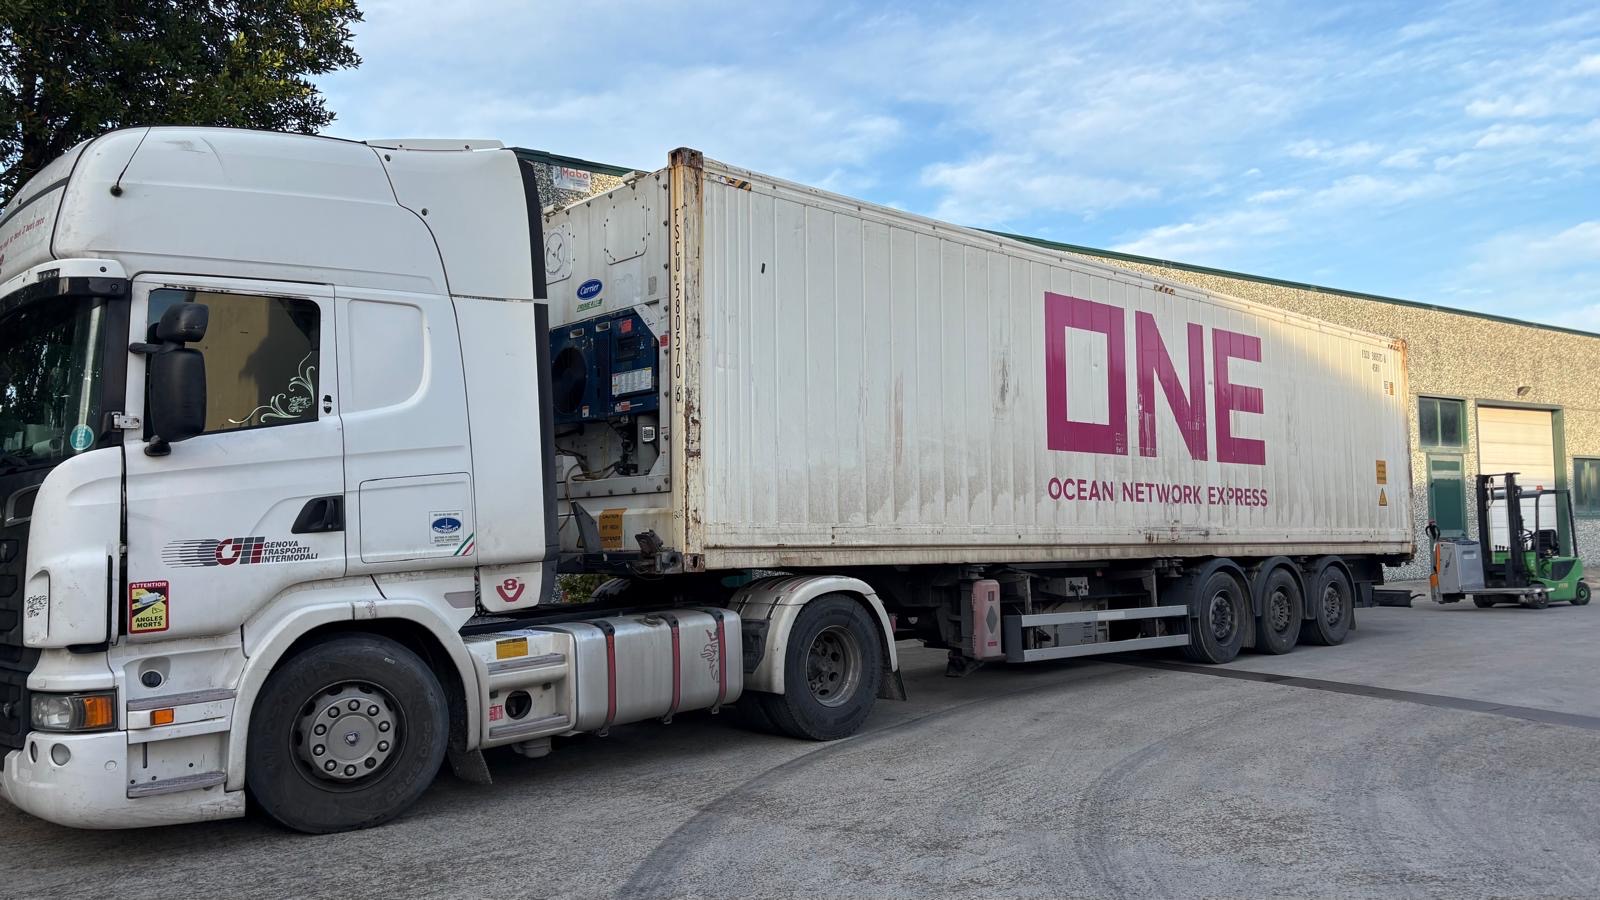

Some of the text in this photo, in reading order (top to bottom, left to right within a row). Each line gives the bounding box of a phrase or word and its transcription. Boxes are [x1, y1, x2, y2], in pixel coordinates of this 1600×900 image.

[561, 167, 589, 179] Mabo
[580, 283, 600, 296] Carrier
[1045, 291, 1266, 465] ONE
[675, 386, 681, 402] 6
[1048, 477, 1268, 507] OCEAN NETWORK EXPRESS
[264, 541, 299, 549] GENOVA
[263, 547, 310, 556] TRASPORTI
[261, 553, 318, 563] INTERMODALI
[135, 615, 163, 623] ANGLES
